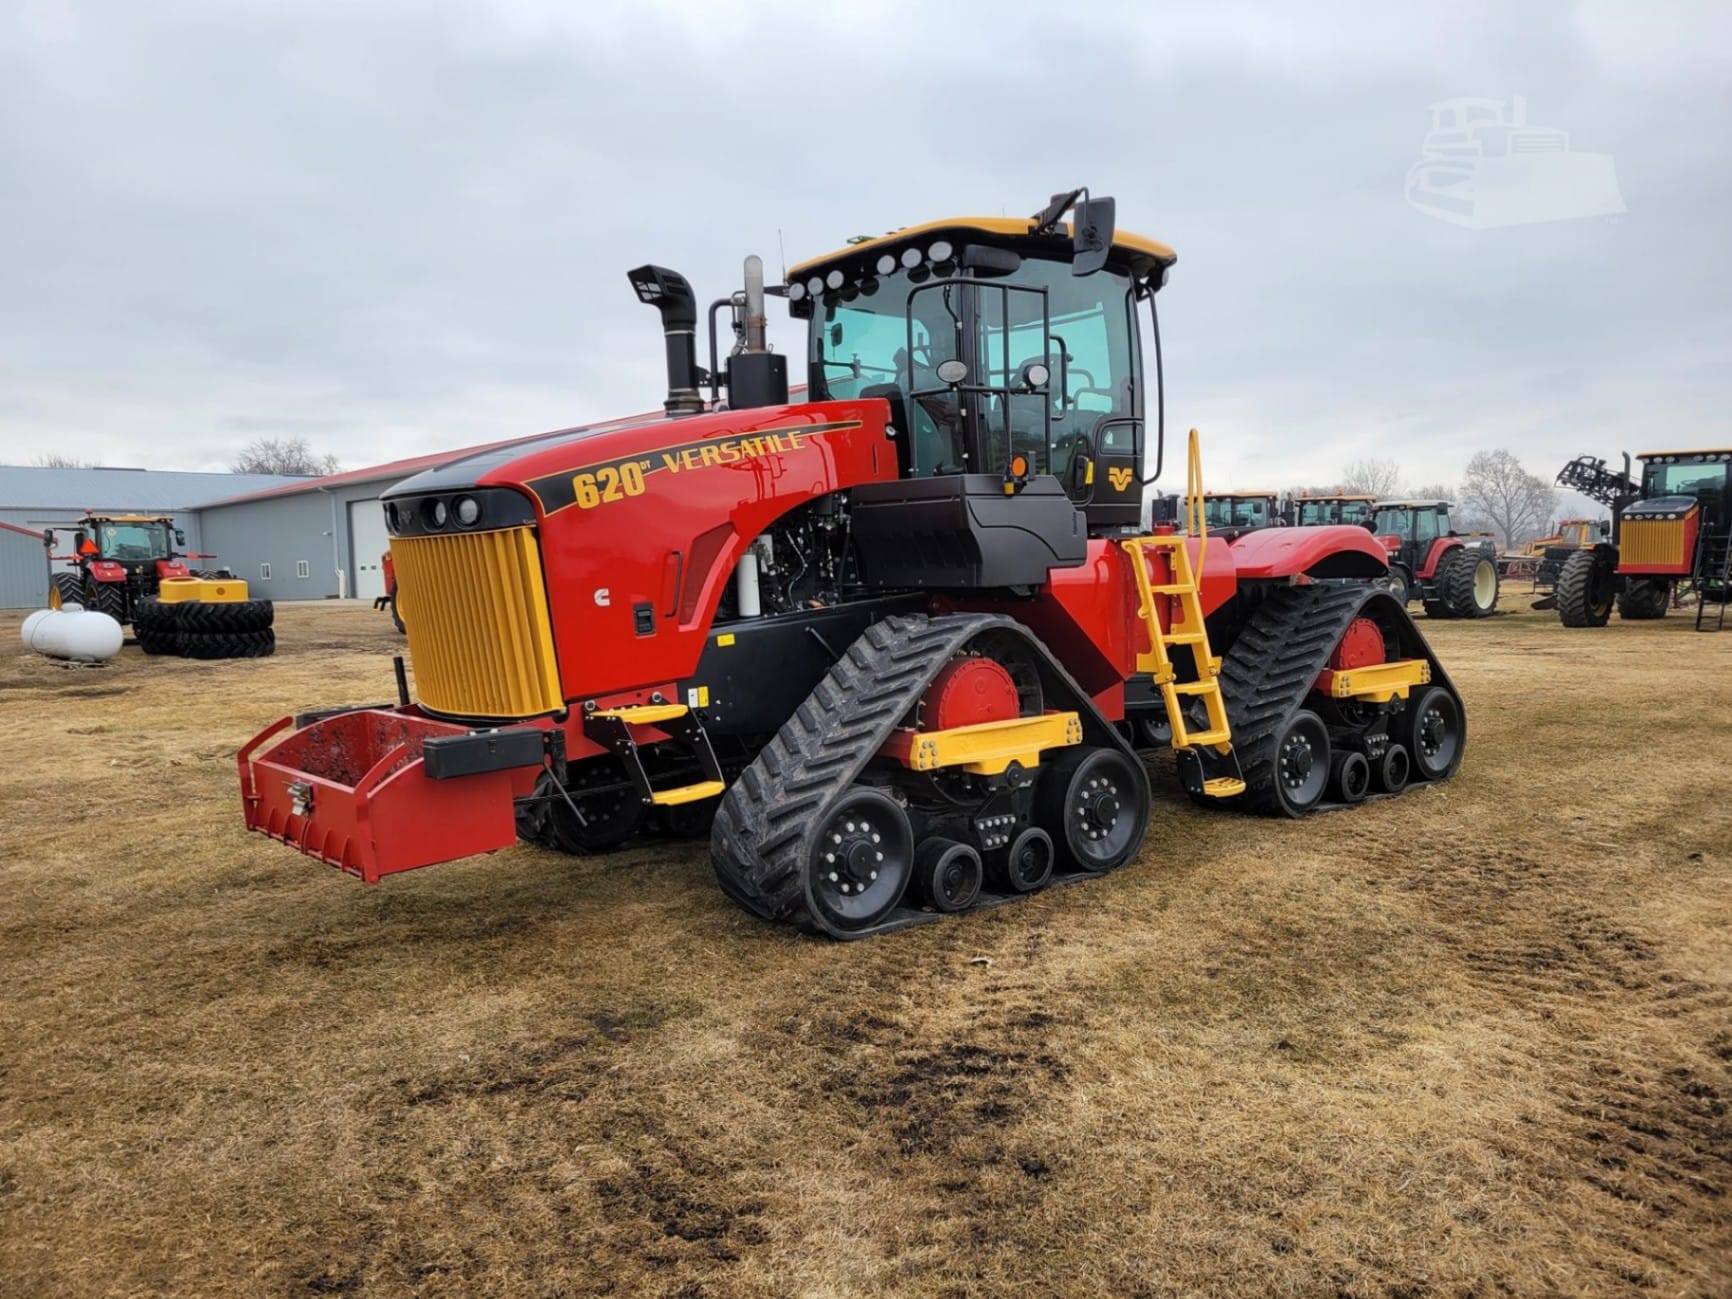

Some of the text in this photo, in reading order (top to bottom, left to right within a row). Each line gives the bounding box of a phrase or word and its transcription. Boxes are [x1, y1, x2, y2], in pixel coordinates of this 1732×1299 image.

[572, 430, 806, 510] 620 DT VERSATILE
